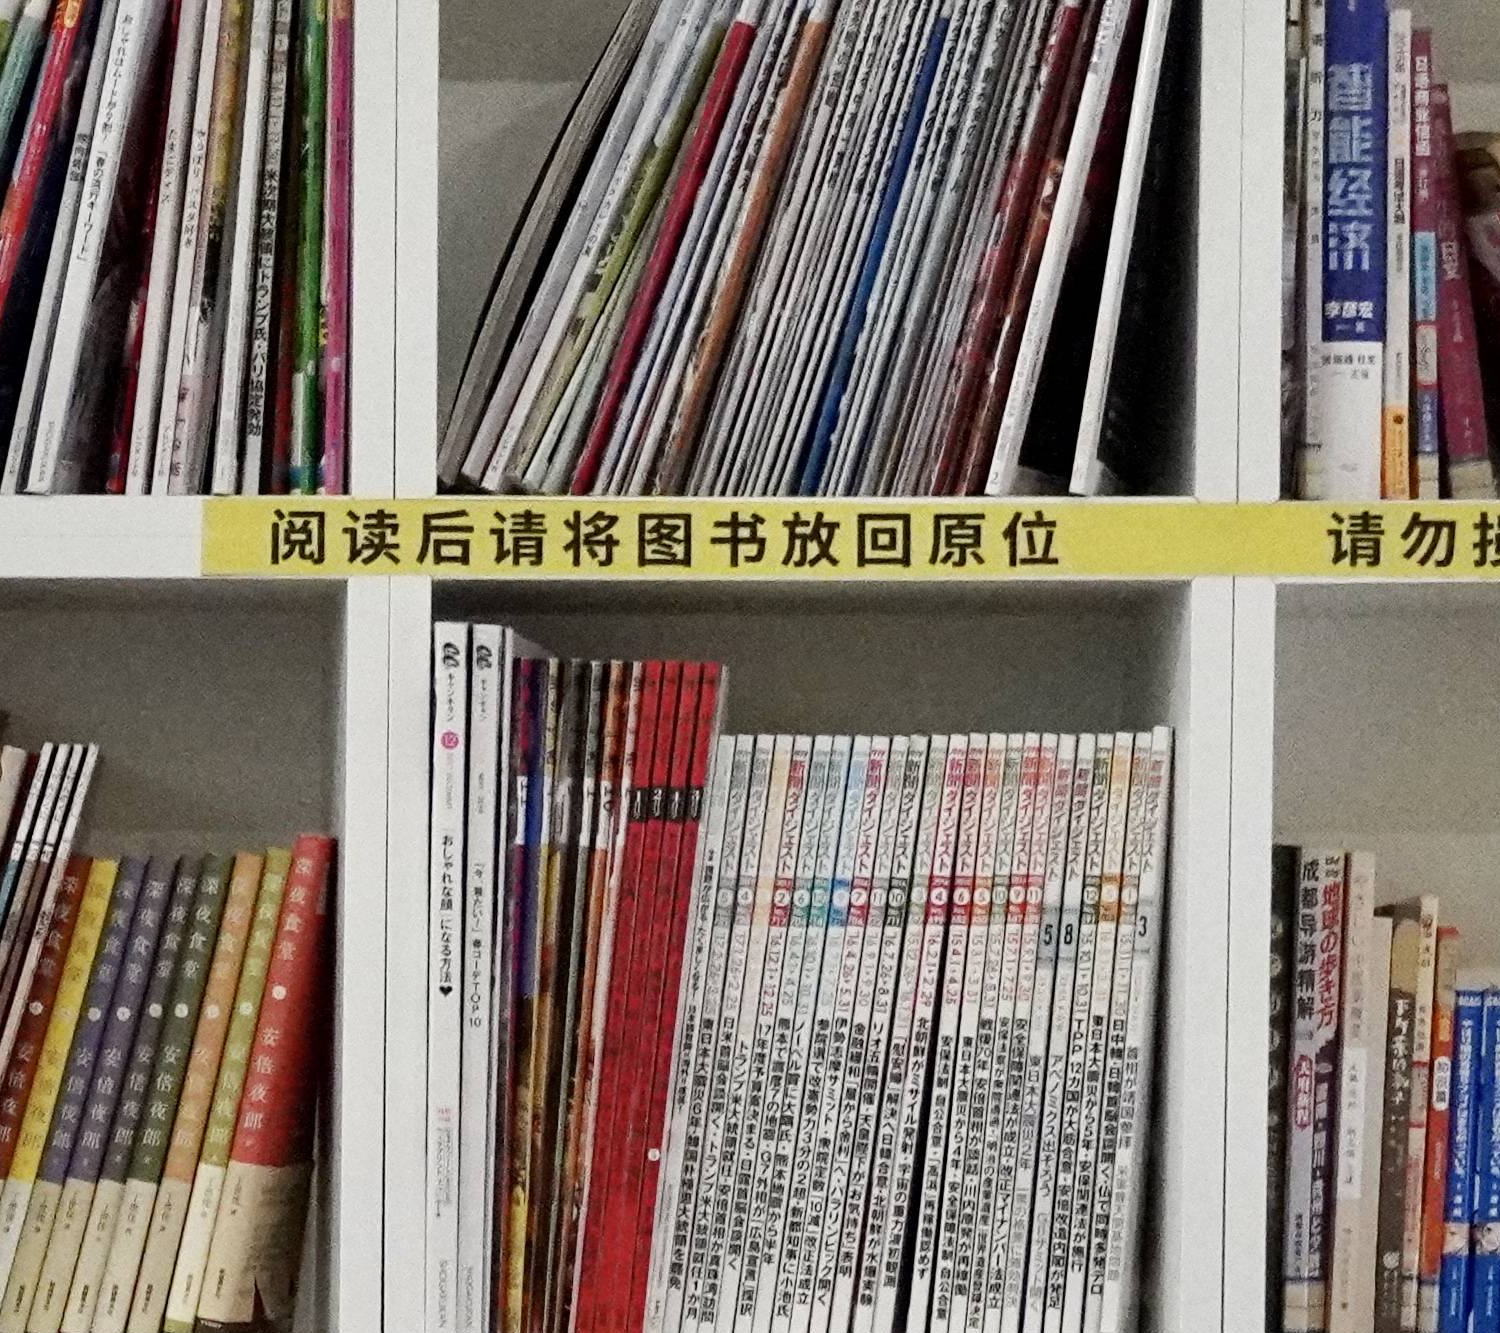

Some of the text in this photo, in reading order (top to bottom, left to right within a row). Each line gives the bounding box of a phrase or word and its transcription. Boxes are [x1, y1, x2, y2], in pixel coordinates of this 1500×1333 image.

[272, 510, 1058, 567] 阅读后请将图书放回原位
